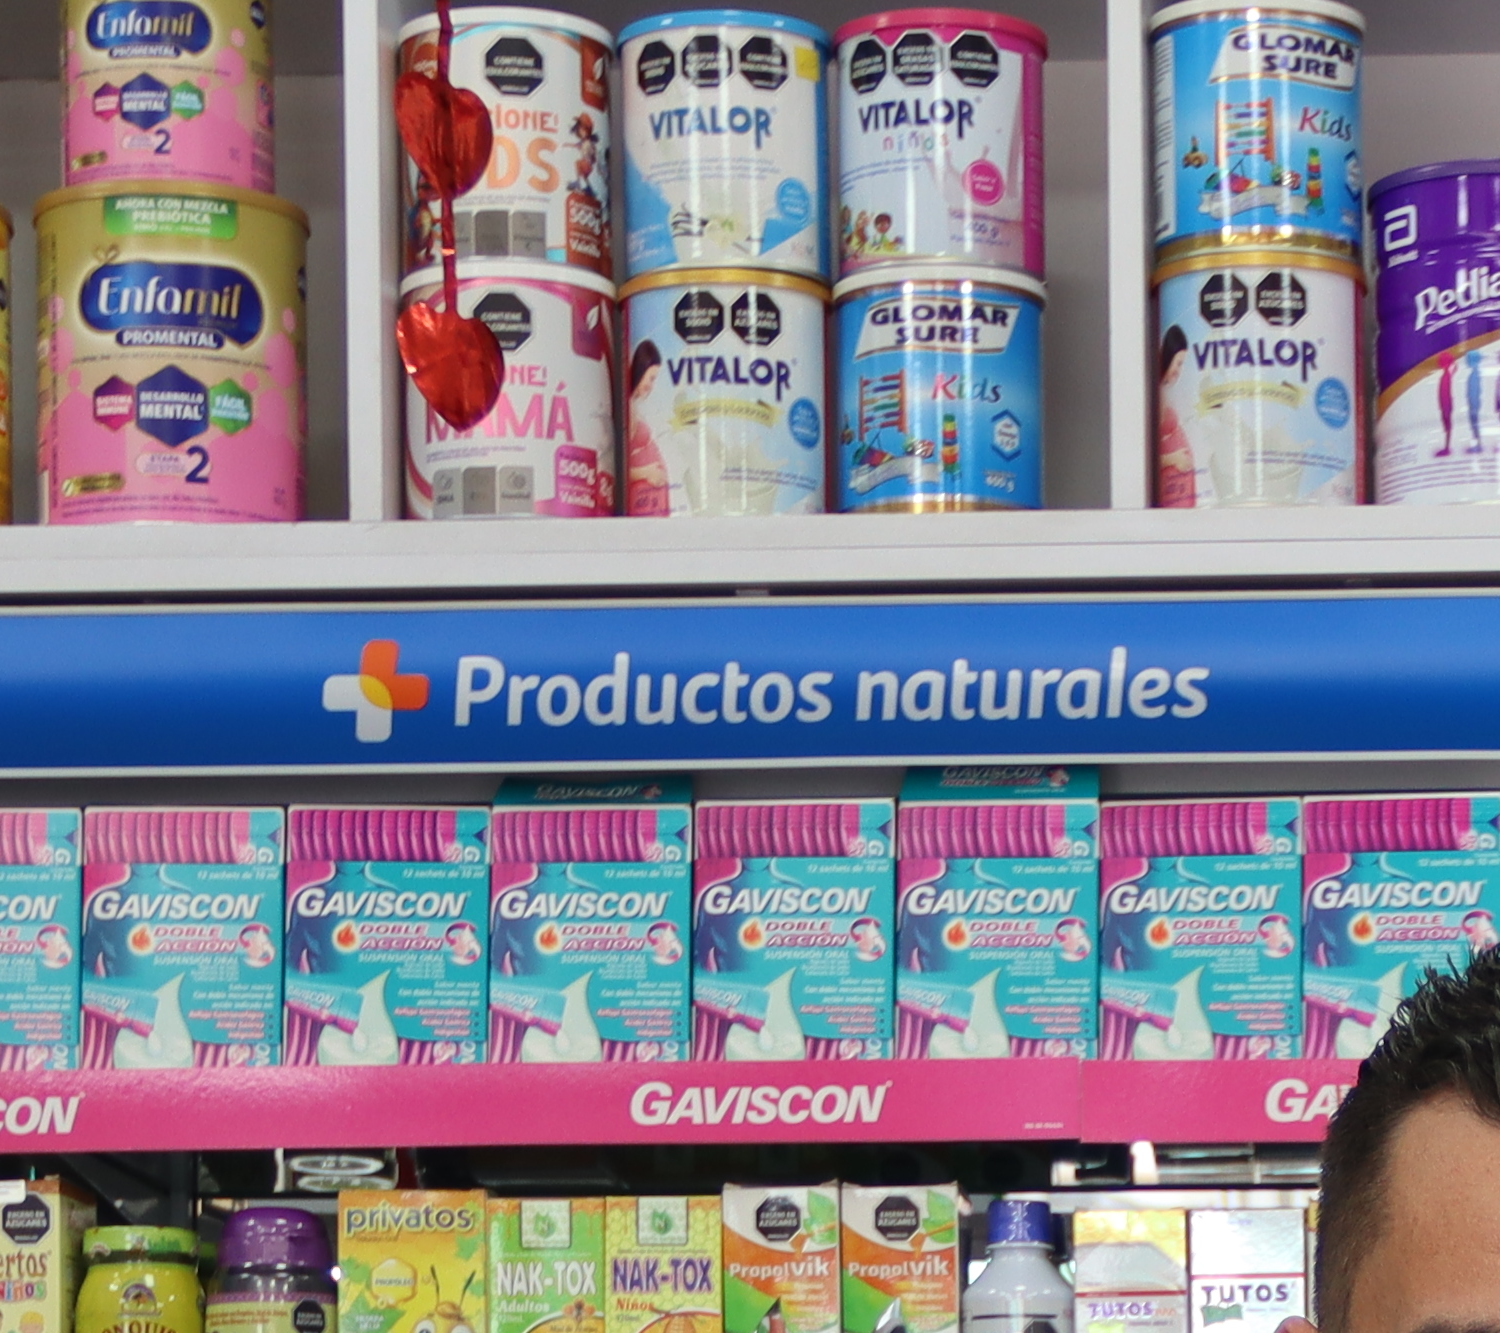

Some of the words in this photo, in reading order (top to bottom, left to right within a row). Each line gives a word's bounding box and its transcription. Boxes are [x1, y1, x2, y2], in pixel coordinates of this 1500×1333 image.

[649, 105, 774, 149] VITALOR
[870, 304, 1010, 329] GLOMAR
[895, 324, 980, 346] SURE
[931, 372, 1002, 404] Kids
[452, 650, 835, 729] Productos
[854, 645, 1212, 724] naturales
[630, 1081, 889, 1129] GAVISCON
[346, 1201, 474, 1239] privatos
[496, 1260, 597, 1296] NAK-TOX
